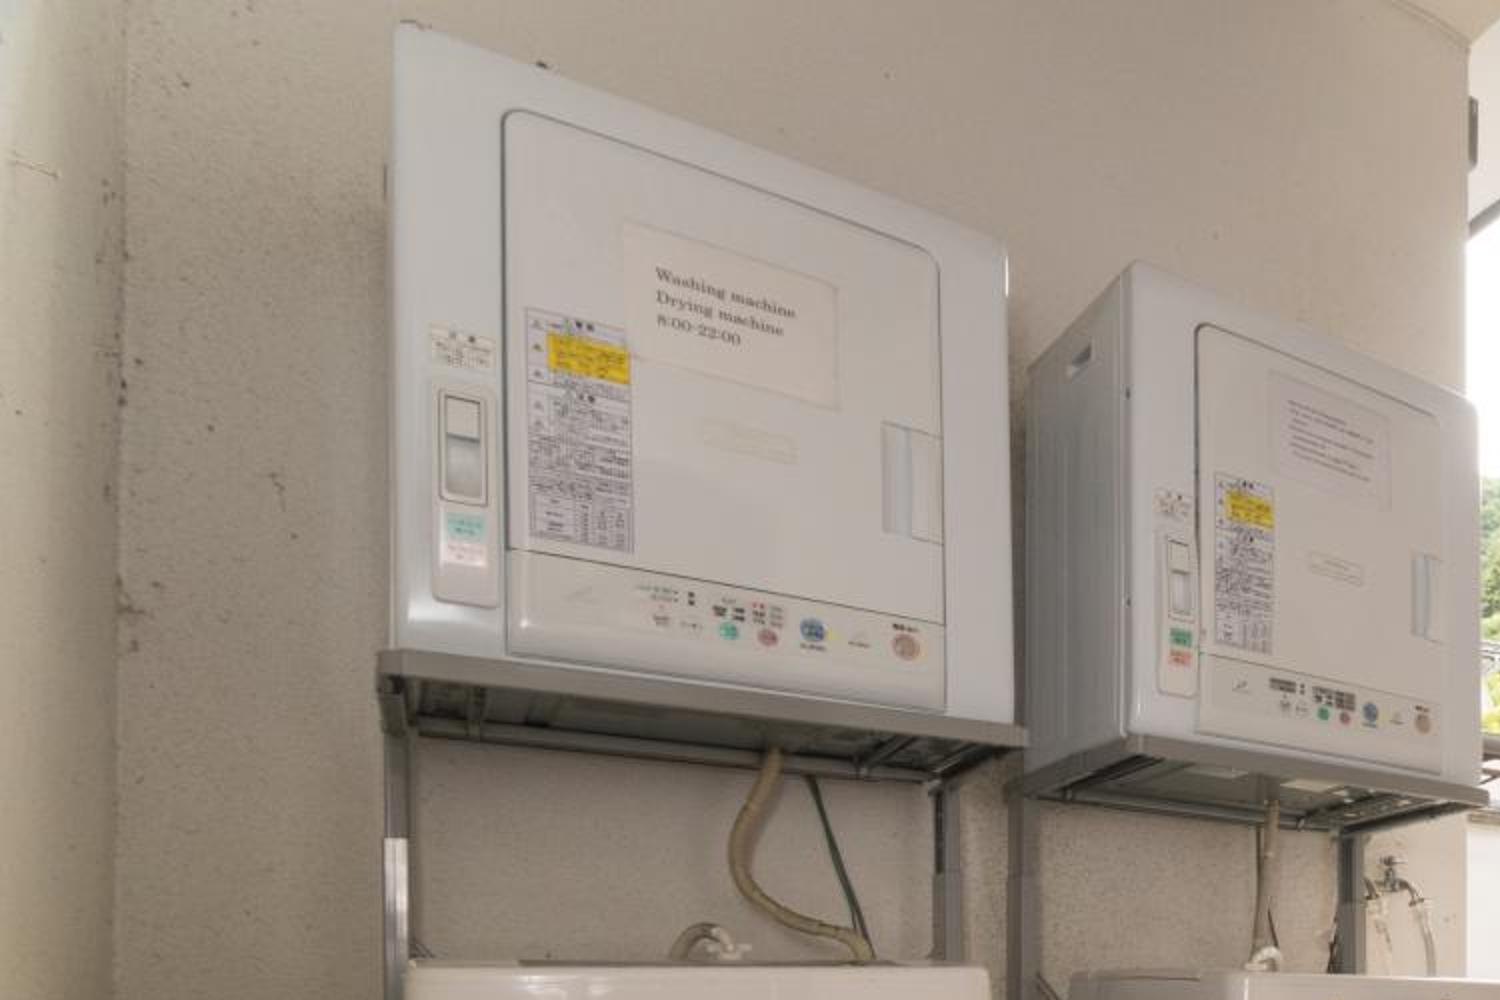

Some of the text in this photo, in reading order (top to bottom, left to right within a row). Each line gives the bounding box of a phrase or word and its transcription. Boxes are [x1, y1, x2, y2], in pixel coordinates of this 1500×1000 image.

[656, 266, 797, 318] Washing machine
[656, 289, 785, 336] Drying machine
